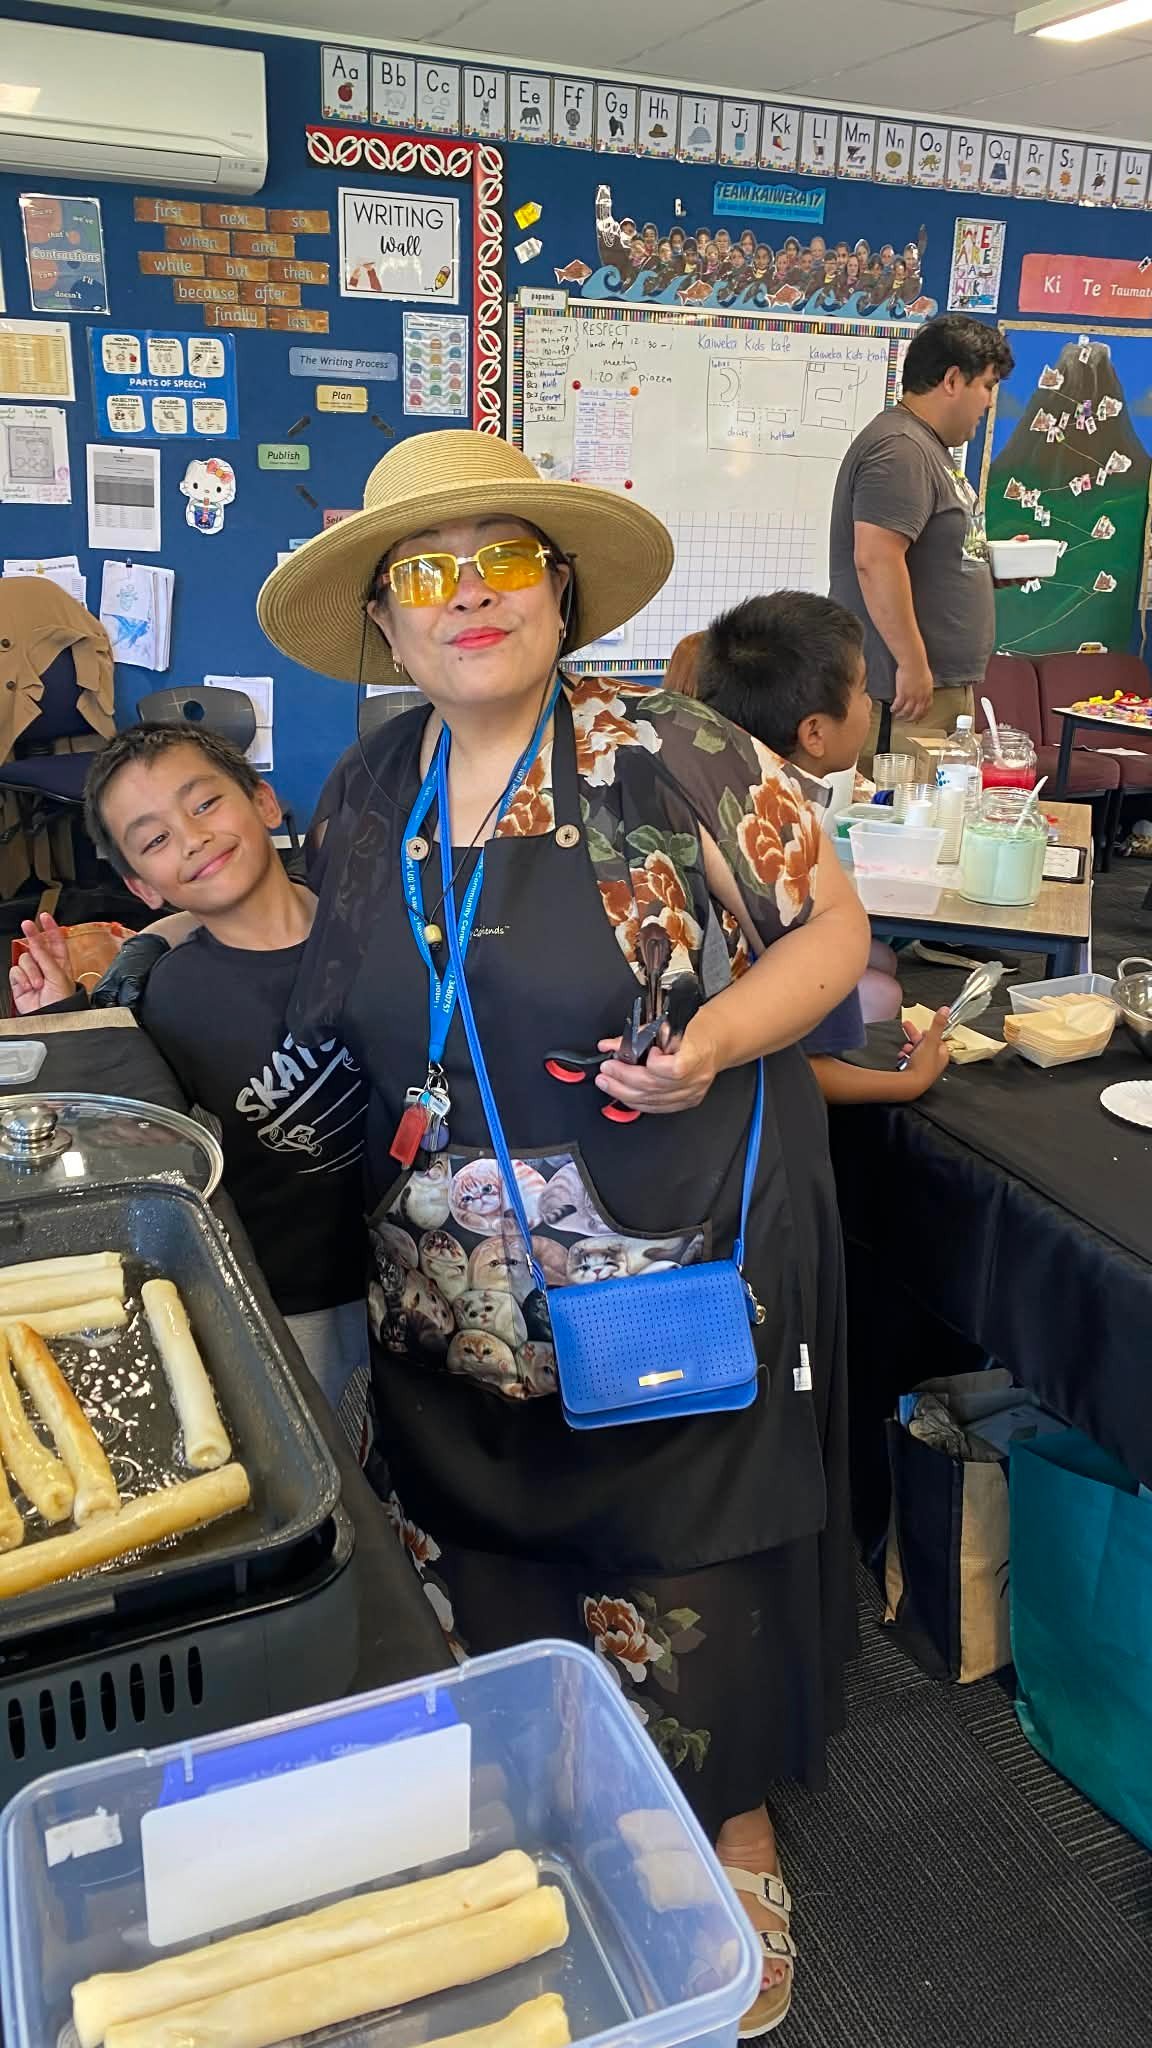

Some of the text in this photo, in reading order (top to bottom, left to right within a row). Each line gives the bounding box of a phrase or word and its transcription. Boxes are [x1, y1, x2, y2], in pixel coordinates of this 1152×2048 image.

[332, 55, 359, 80] Aa
[382, 61, 407, 87] Bb
[426, 69, 450, 94] Cc
[473, 75, 497, 100] Dd
[519, 80, 541, 104] Ee
[563, 85, 585, 109] Ff
[605, 91, 628, 119] Gg
[649, 96, 669, 120] Hh
[693, 102, 707, 125] Ii
[731, 107, 749, 133] Jj
[770, 111, 791, 135] Kk
[812, 117, 828, 139] Ll
[844, 121, 871, 145] Mm
[885, 127, 905, 149] Nn
[920, 132, 943, 153] Oo
[958, 135, 975, 160] Pp
[988, 139, 1011, 166] Qq
[1027, 143, 1045, 164] Rr
[1059, 148, 1075, 169] Ss
[1095, 152, 1107, 173] Tt
[1126, 155, 1143, 176] Uu
[717, 183, 750, 200] TEAM
[751, 185, 807, 206] KAIWEKA
[809, 192, 822, 208] 17
[153, 201, 182, 223] first
[219, 212, 249, 226] next
[291, 216, 307, 228] so
[353, 201, 444, 230] WRITING
[179, 234, 218, 250] when
[251, 238, 278, 254] and
[31, 246, 101, 263] Contractions
[154, 256, 192, 273] while
[225, 260, 249, 277] but
[282, 264, 313, 281] then
[178, 282, 236, 300] because
[254, 286, 288, 305] after
[1043, 275, 1061, 294] Ki
[1082, 278, 1102, 297] Te
[213, 305, 258, 327] finally
[287, 313, 311, 329] last
[582, 321, 630, 337] RESPECT
[300, 355, 389, 369] The Writing Process
[129, 377, 207, 390] PARTS OF SPEECH
[331, 390, 352, 401] Plan
[267, 450, 301, 461] Publish
[463, 871, 481, 919] Community
